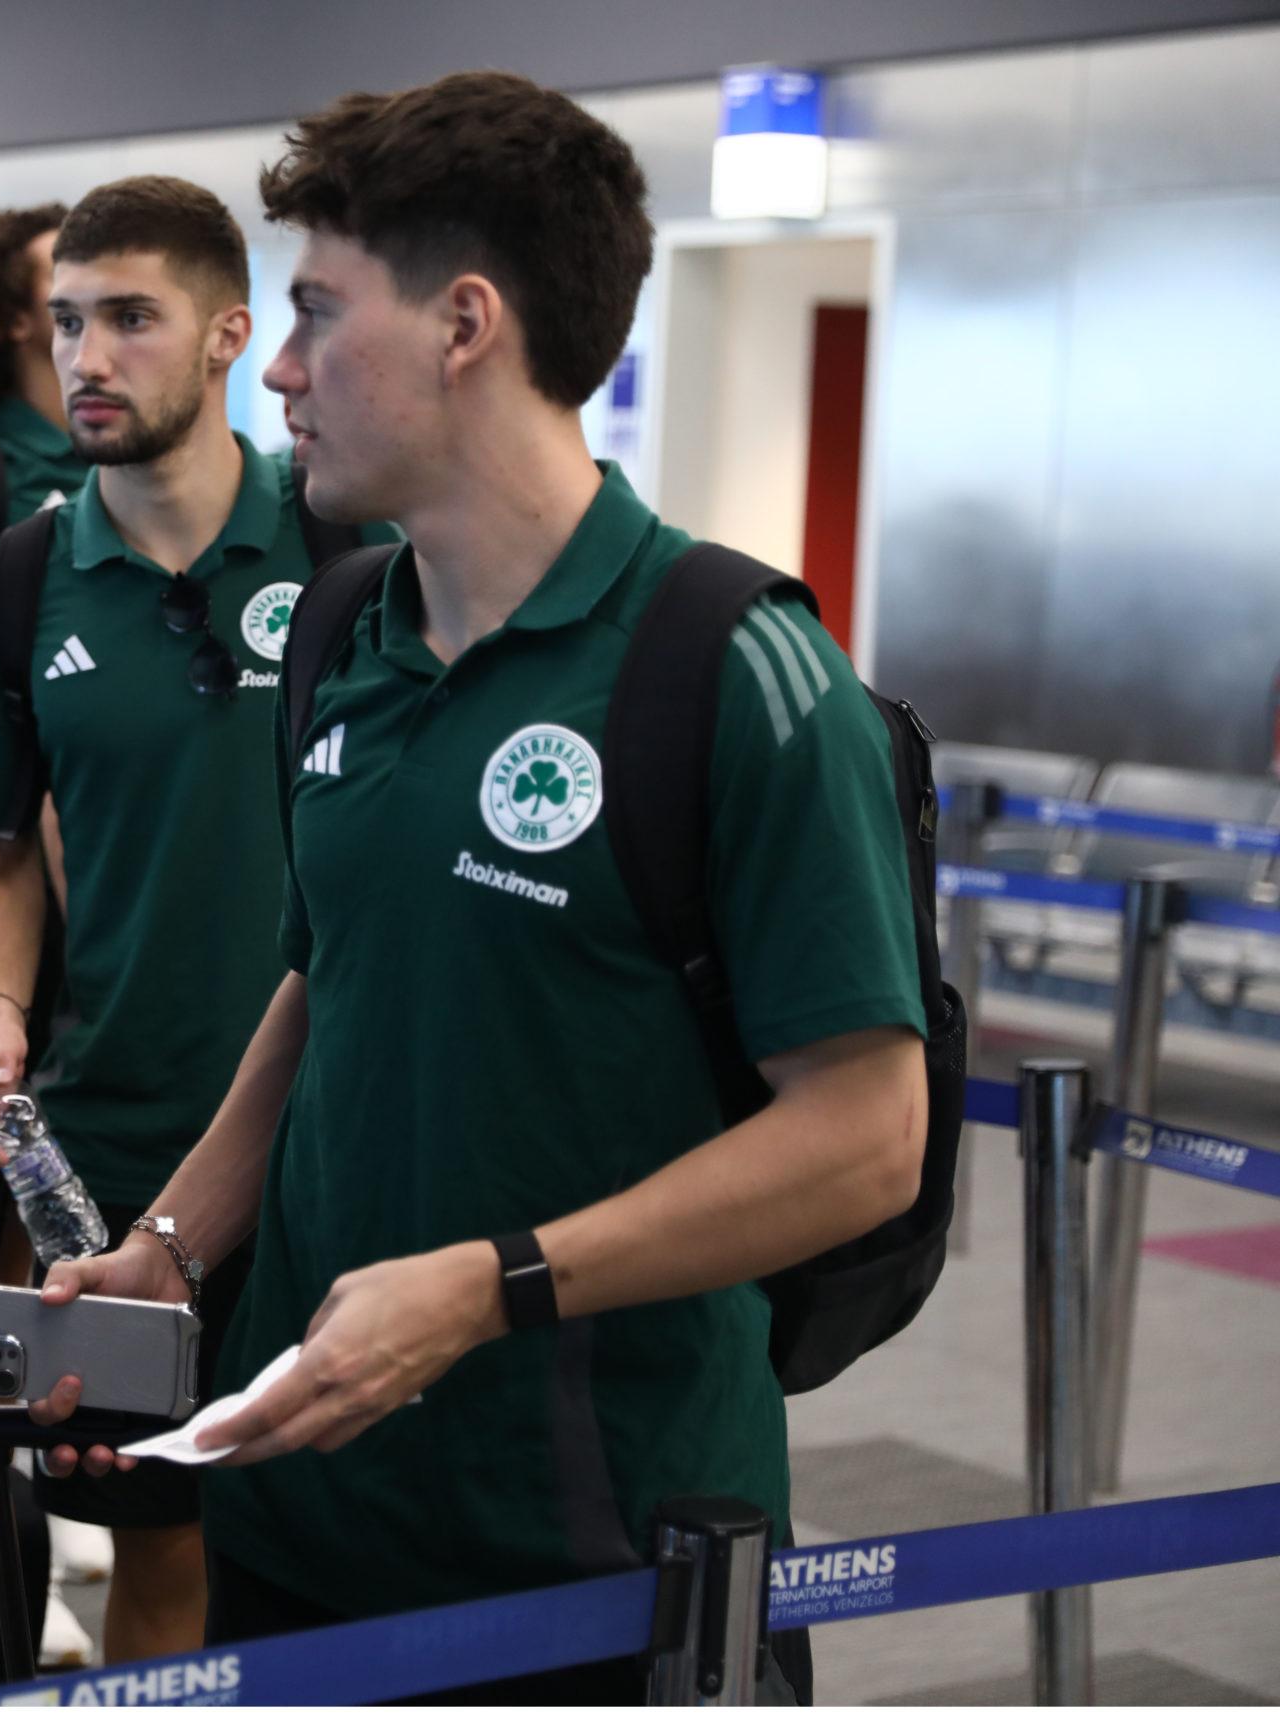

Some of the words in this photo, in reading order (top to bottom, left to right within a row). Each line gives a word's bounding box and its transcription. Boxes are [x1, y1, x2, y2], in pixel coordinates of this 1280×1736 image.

[514, 822, 549, 841] 1908
[452, 850, 569, 908] Stoiximan
[1156, 1128, 1250, 1168] ATHENS
[770, 1544, 897, 1589] ATHENS
[848, 1575, 895, 1595] AIRPORT
[833, 1591, 894, 1612] VENIZELOS
[70, 1655, 240, 1706] ATHENS
